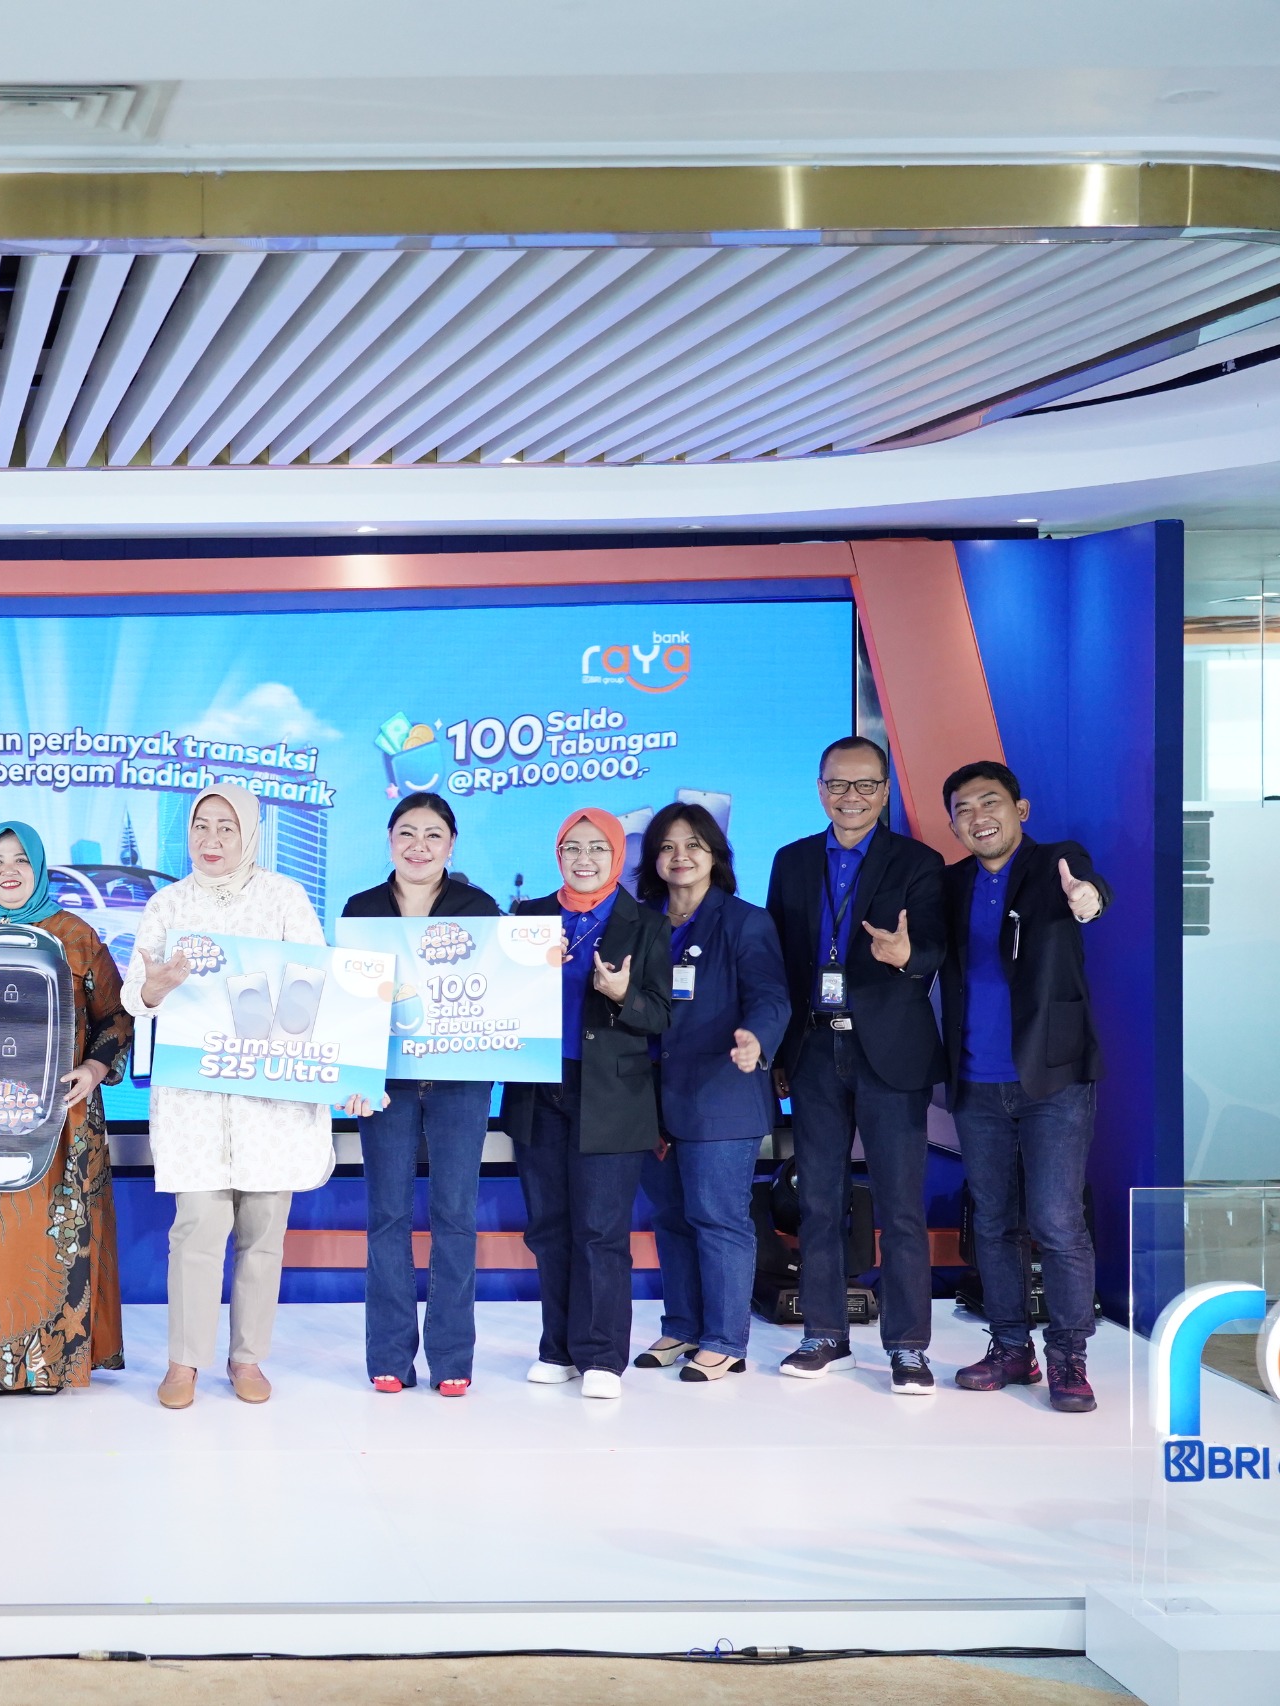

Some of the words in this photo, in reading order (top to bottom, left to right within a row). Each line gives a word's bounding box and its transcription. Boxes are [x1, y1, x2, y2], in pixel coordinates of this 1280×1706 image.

[652, 630, 690, 644] bank
[546, 706, 624, 733] Saldo
[28, 726, 178, 760] perbanyak
[182, 735, 318, 773] transaksi
[446, 714, 544, 761] 100
[545, 730, 677, 757] Tabungan
[120, 759, 216, 788] hadiah
[421, 930, 469, 950] Pesta
[425, 943, 467, 960] Raya
[187, 957, 217, 972] aya
[426, 972, 488, 1003] 100
[426, 1001, 484, 1018] Saldo
[426, 1018, 520, 1036] Tabungan
[201, 1030, 340, 1065] Samsung
[198, 1054, 256, 1080] S25
[263, 1057, 340, 1083] Ultra
[1208, 1446, 1271, 1480] BRI
